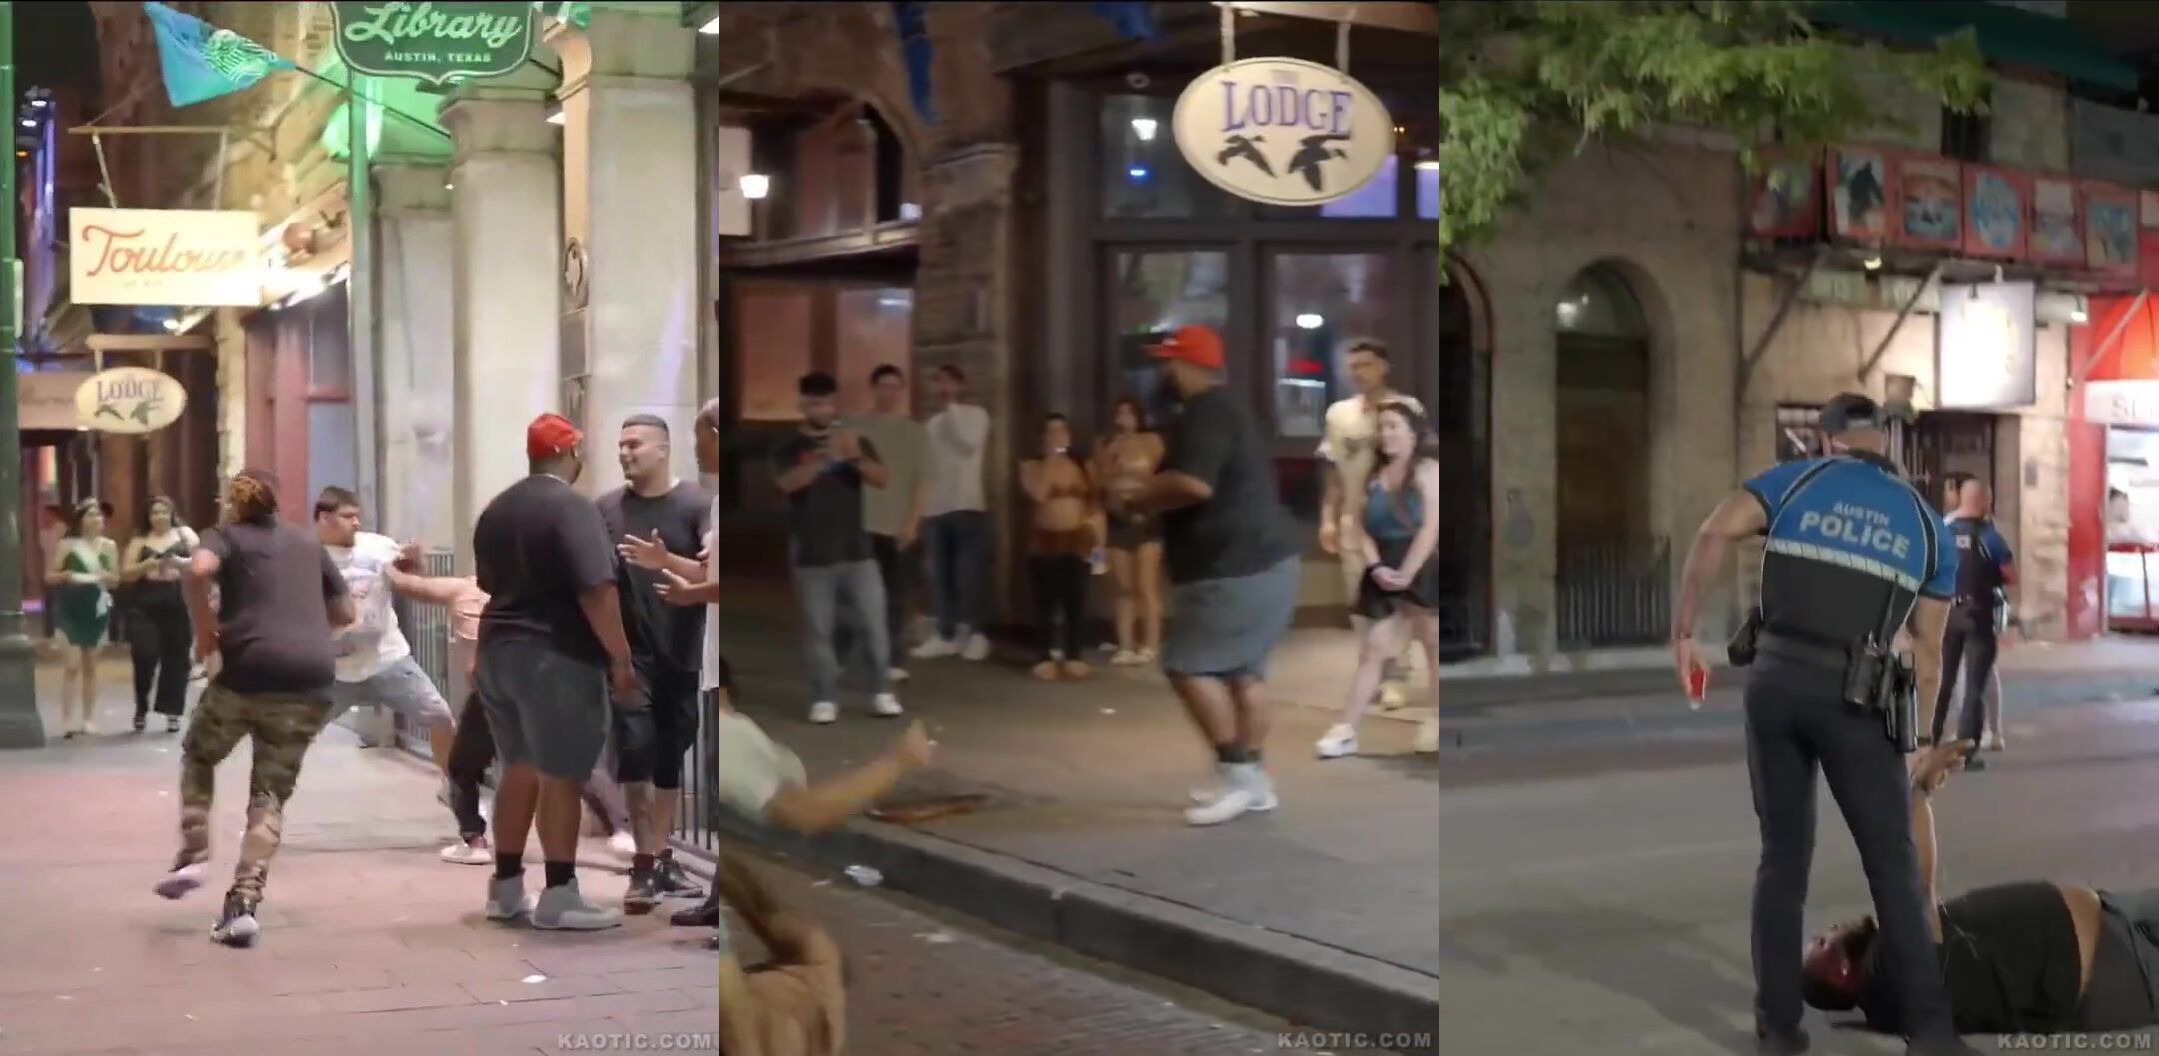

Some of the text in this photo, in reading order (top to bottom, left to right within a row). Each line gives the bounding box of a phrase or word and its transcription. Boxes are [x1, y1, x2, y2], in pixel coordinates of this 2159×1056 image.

[345, 2, 523, 48] Library
[384, 52, 492, 64] AUSTIN, TEXAS
[1220, 80, 1352, 134] LODGE
[1800, 510, 1911, 560] POLICE
[1832, 501, 1891, 528] AUSTIN
